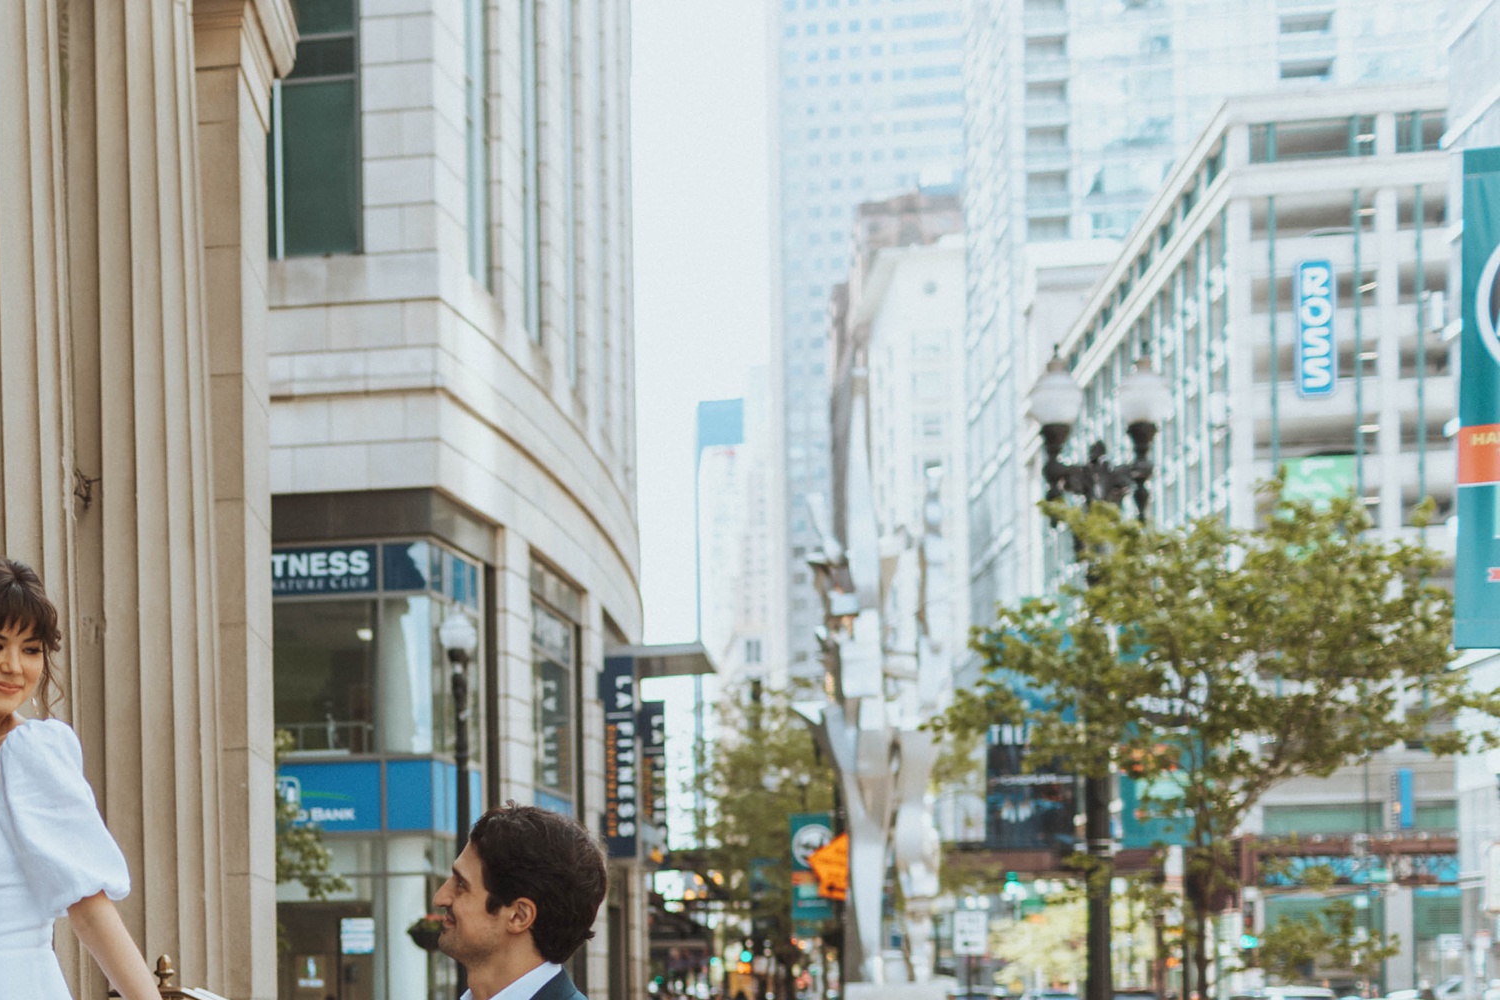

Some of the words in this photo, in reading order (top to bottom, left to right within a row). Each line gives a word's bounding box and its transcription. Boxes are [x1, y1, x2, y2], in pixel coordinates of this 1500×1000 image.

[1301, 266, 1332, 388] ROSS
[271, 549, 370, 578] TNESS
[615, 675, 633, 709] LA
[617, 721, 635, 837] FITNESS
[311, 807, 355, 822] BANK
